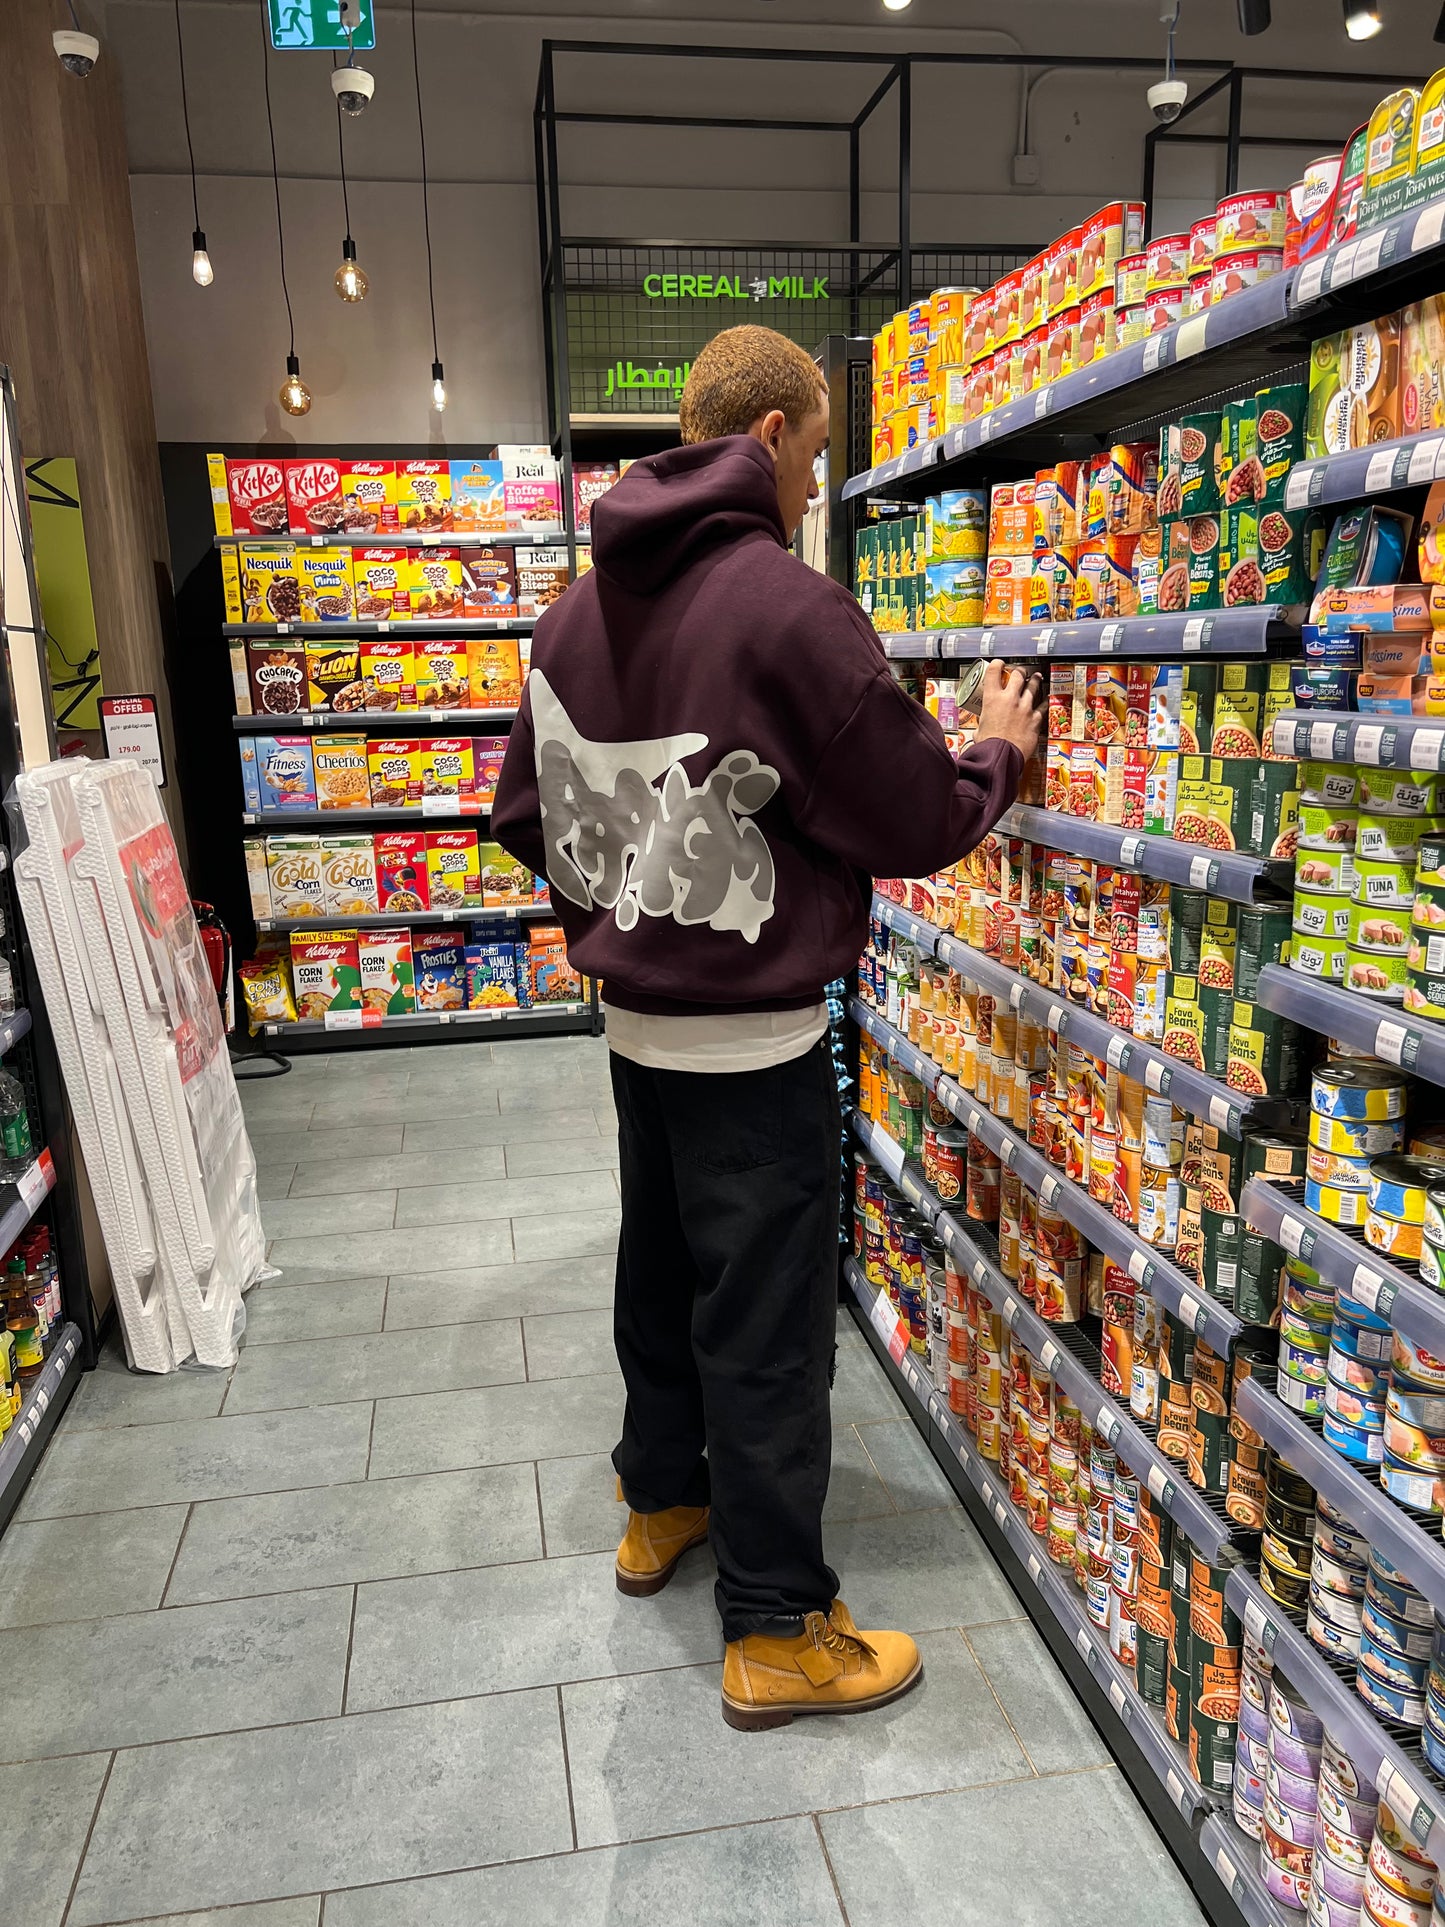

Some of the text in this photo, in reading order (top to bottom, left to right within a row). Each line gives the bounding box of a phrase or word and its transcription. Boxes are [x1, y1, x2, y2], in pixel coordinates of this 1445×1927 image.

[1406, 179, 1427, 200] JOHN
[1380, 188, 1402, 206] WEST
[1224, 199, 1255, 216] HANA
[1148, 243, 1171, 257] HANA
[643, 274, 750, 298] CEREAL
[768, 276, 830, 299] MILK
[351, 463, 384, 476] Kellogg's
[406, 461, 441, 475] Kellogg's
[238, 466, 280, 498] KitKat
[294, 466, 337, 498] KitKat
[506, 485, 545, 496] Toffee
[506, 495, 536, 505] Bites
[363, 550, 397, 561] Kellogg's
[418, 549, 452, 561] Kellogg's
[246, 557, 293, 571] Nesquik
[304, 559, 347, 572] Nesquik
[314, 574, 341, 588] Minis
[519, 571, 556, 582] Choco
[519, 580, 549, 591] Bites
[370, 644, 402, 656] Kellogg's
[424, 641, 458, 655] Kellogg's
[320, 653, 358, 676] LION
[259, 667, 300, 682] CHOCAPIC
[1314, 687, 1344, 697] EUROPEAN
[1221, 694, 1248, 706] فول
[113, 704, 144, 714] OFFER
[118, 745, 141, 754] 179.00
[377, 743, 410, 754] Kellogg's
[430, 741, 462, 752] Kellogg's
[266, 754, 306, 771] Fitness
[316, 754, 366, 769] Cheerios
[1326, 780, 1354, 796] تونة
[1396, 789, 1428, 806] تونة
[383, 835, 417, 848] Kellogg's
[437, 834, 467, 846] Kellogg's
[1362, 833, 1383, 846] TUNA
[277, 861, 316, 888] Gold
[330, 859, 368, 887] Gold
[295, 880, 321, 890] Corn
[348, 877, 373, 888] Corn
[1367, 880, 1394, 893] TUNA
[1302, 911, 1325, 926] تونة
[1334, 915, 1349, 926] TU
[292, 931, 357, 943] FAMILY SIZE 750g
[368, 934, 401, 943] Kellogg's
[423, 935, 455, 946] Kellogg's
[305, 945, 348, 959] Kellogg's
[361, 957, 385, 966] CORN
[420, 949, 457, 969] FROSTIES
[488, 955, 514, 967] VANILLA
[1300, 951, 1323, 967] تونة
[1332, 957, 1346, 968] TU
[298, 967, 323, 977] CORN
[362, 965, 386, 973] FLAKES
[492, 967, 515, 980] FLAKES
[247, 973, 281, 995] CORN
[299, 976, 323, 984] FLAKES
[250, 985, 282, 1003] FLAKES
[1173, 1007, 1193, 1018] Fava
[1232, 1035, 1249, 1048] Fava
[1169, 1411, 1189, 1423] Fava
[1164, 1417, 1190, 1432] Bean
[1237, 1474, 1256, 1489] Fava
[1232, 1478, 1264, 1500] Beans
[1379, 1855, 1410, 1885] Rose
